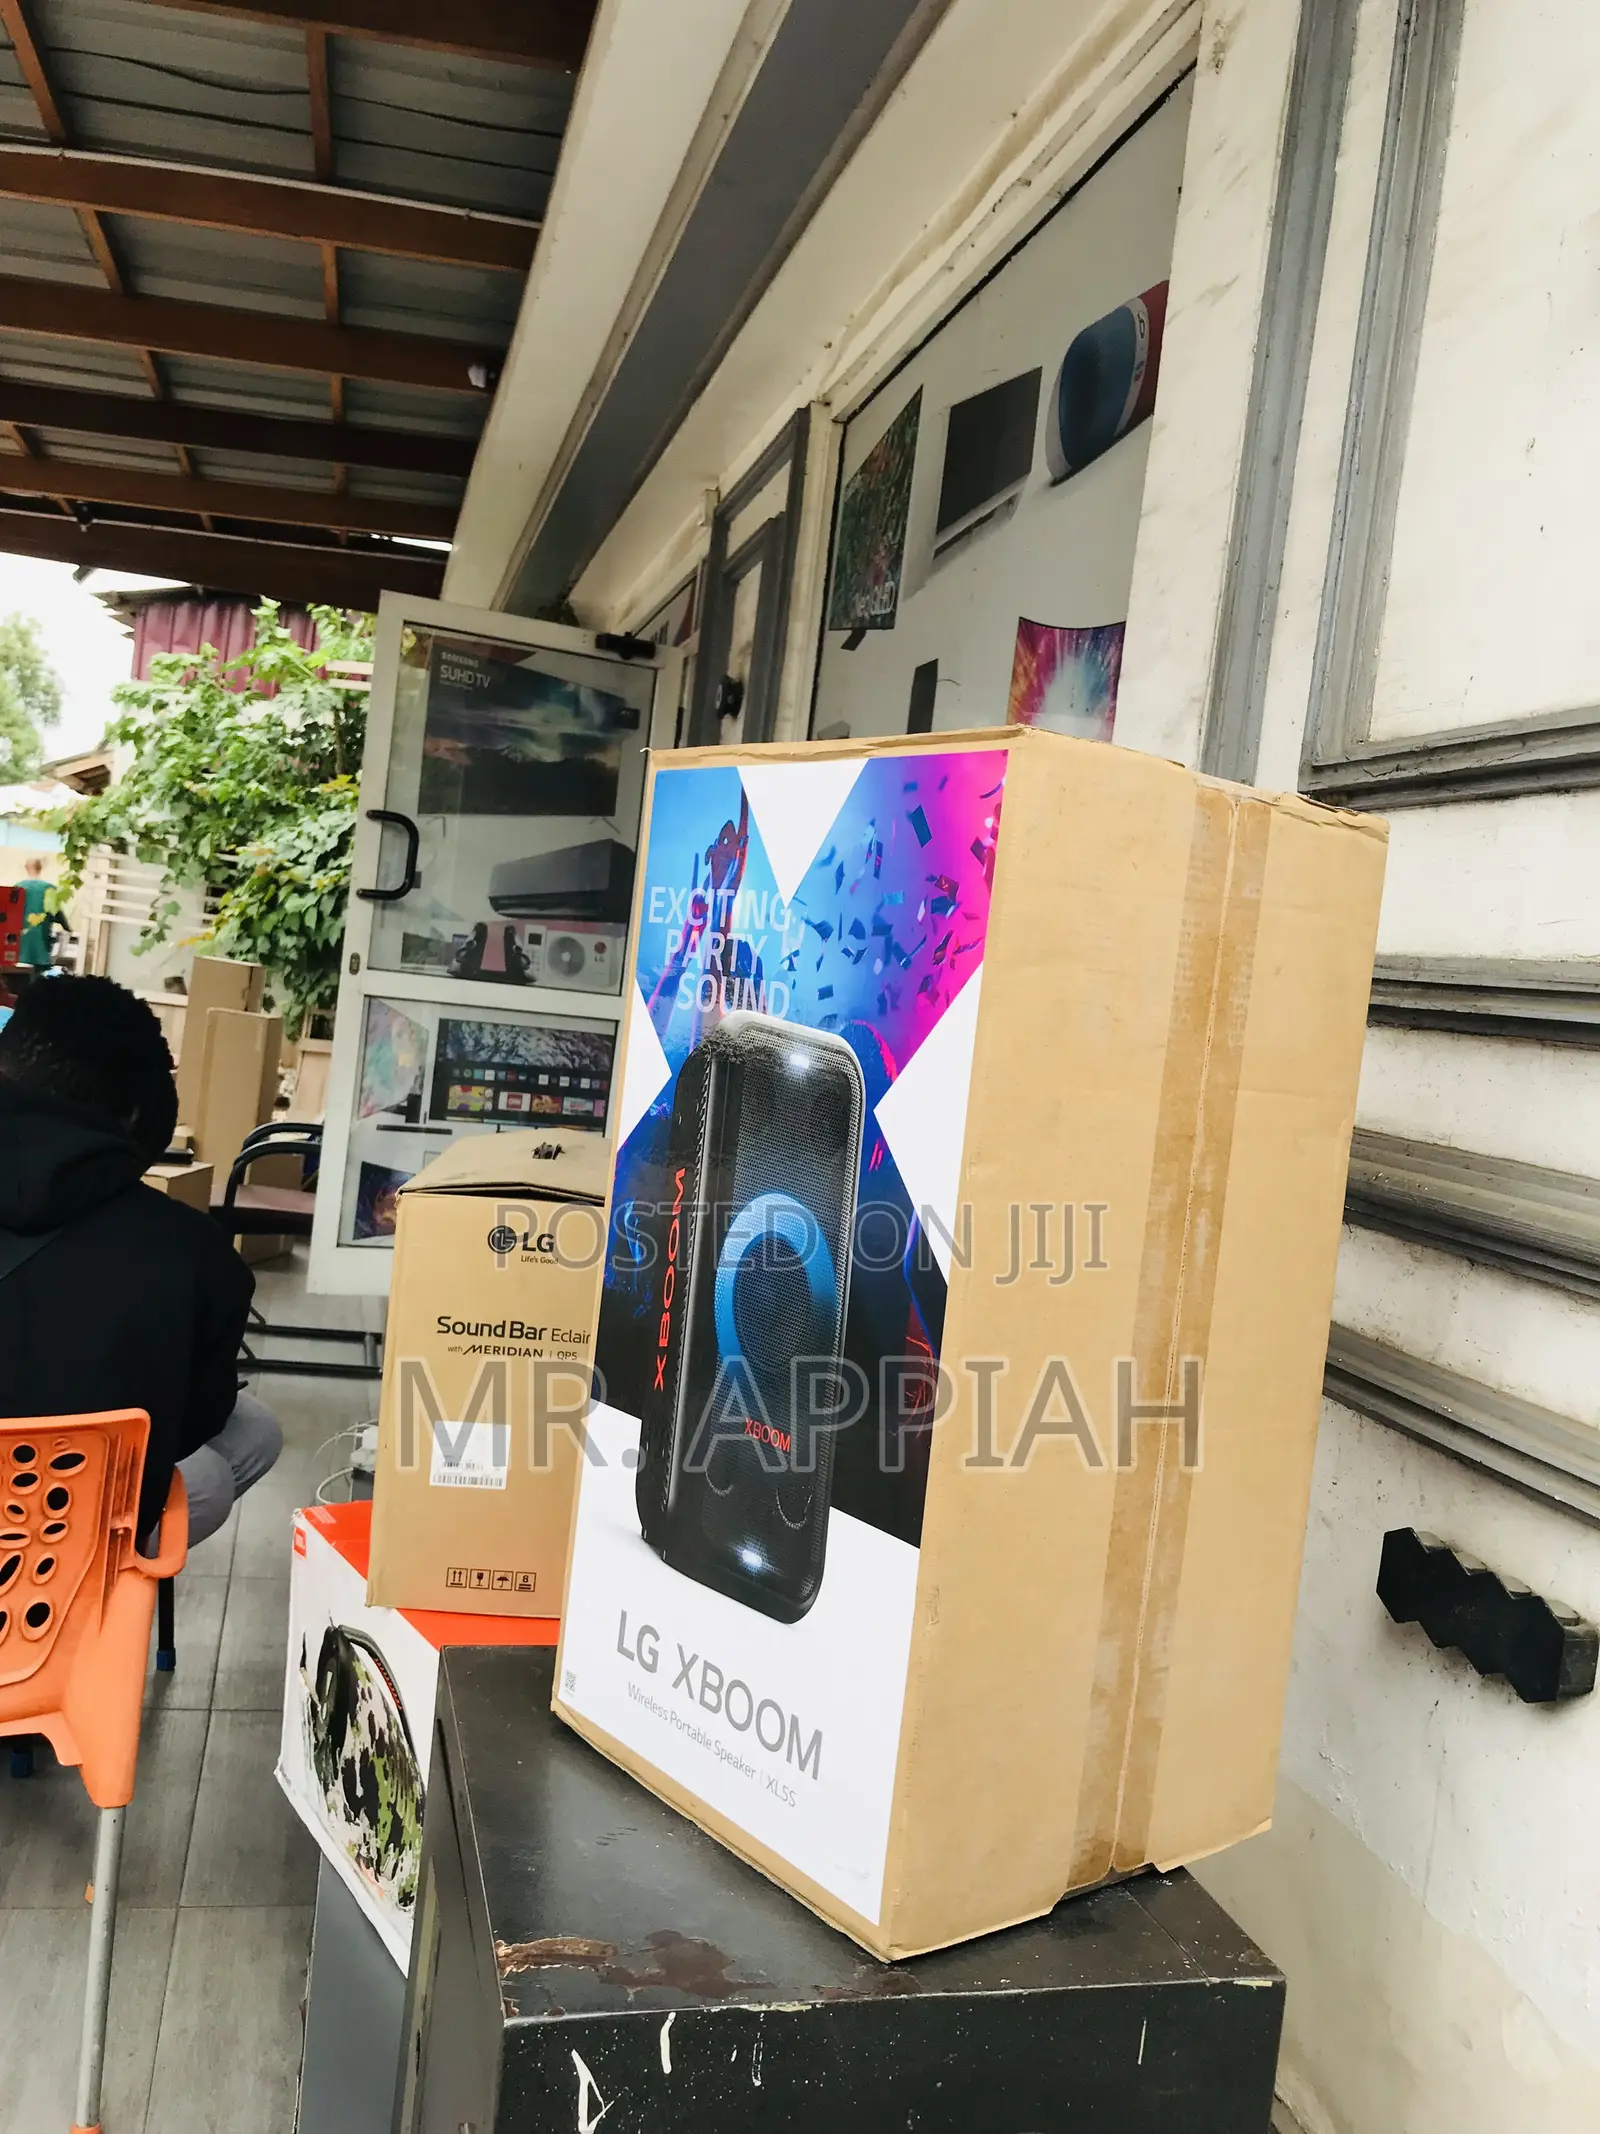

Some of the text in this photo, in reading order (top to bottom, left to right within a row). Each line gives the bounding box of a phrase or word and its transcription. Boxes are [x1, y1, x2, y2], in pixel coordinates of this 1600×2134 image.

[648, 886, 792, 932] EXCITING
[664, 928, 769, 975] PARTY
[677, 971, 791, 1019] SOUND
[520, 1254, 559, 1265] Life's Good
[521, 1232, 555, 1253] LG
[653, 1167, 687, 1392] XBOOM
[448, 1344, 578, 1361] with MERIDIAN QP5
[551, 1328, 591, 1345] Eclair
[744, 1416, 792, 1453] XBOOM
[617, 1609, 823, 1781] LG XBOOM
[628, 1681, 797, 1808] Wireless Portable Speaker XL5S
